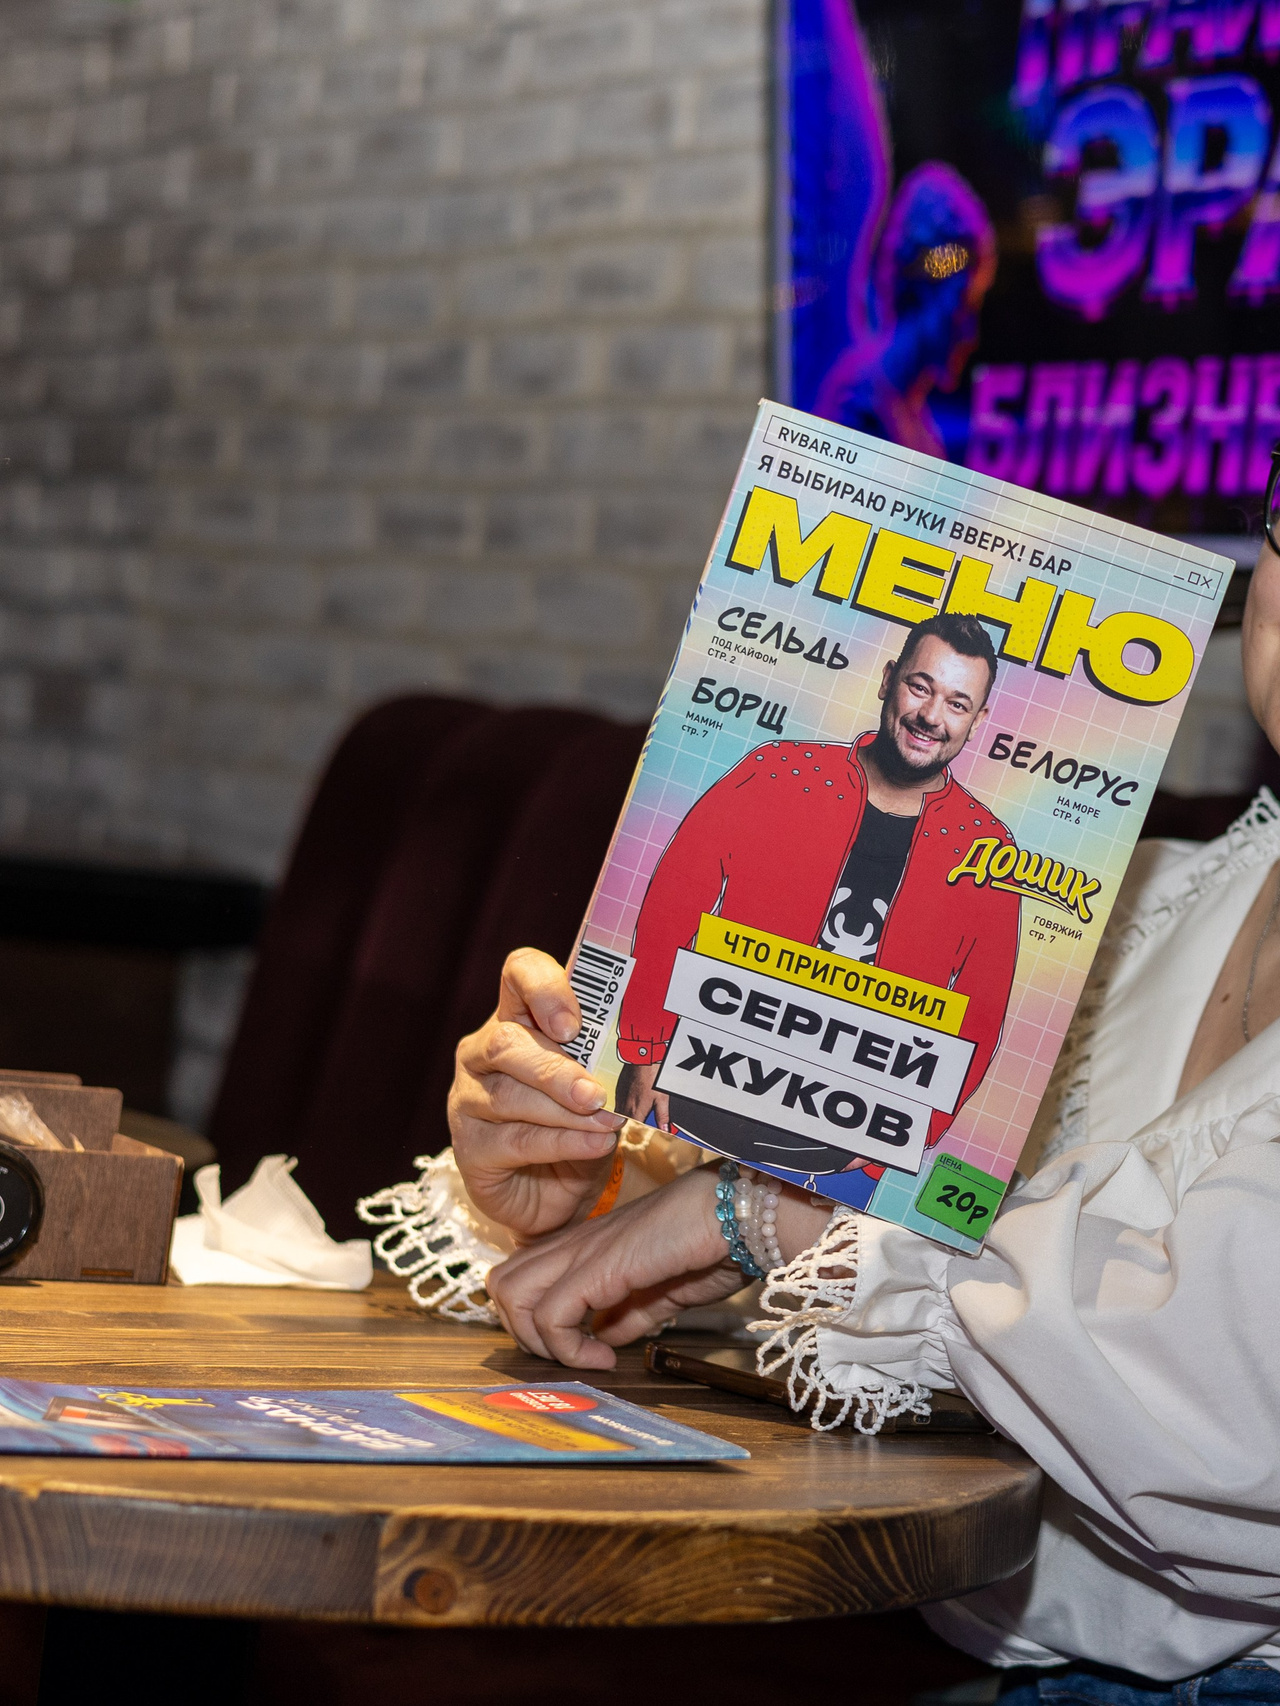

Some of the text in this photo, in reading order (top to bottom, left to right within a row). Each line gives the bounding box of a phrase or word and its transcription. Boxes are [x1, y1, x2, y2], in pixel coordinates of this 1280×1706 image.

[778, 426, 858, 465] RVBAR.RU
[758, 454, 1072, 577] Я ВЫБИРАЮ РУКИ ВВЕРХ! БАР
[725, 485, 1196, 704] МЕНЮ
[707, 647, 736, 665] СТР. 2
[711, 635, 778, 666] ПОД КАЙФОМ
[717, 606, 849, 670] СЕЛЬДЬ
[685, 710, 723, 731] МАМИН
[691, 676, 787, 735] БОРЩ
[681, 724, 709, 739] стр. 7
[988, 733, 1139, 807] БЕЛОРУС
[1052, 808, 1081, 825] СТР. 6
[1056, 796, 1101, 819] НА МОРЕ
[1028, 929, 1056, 944] стр. 7
[1033, 915, 1083, 941] ГОВЯЖИЙ
[723, 931, 947, 1021] ЧТО ПРИГОТОВИЛ
[580, 964, 625, 1069] ADE IN 90'S
[698, 977, 940, 1089] СЕРГЕЙ
[675, 1034, 914, 1148] ЖУКОВ
[940, 1155, 962, 1171] ЦЕНА
